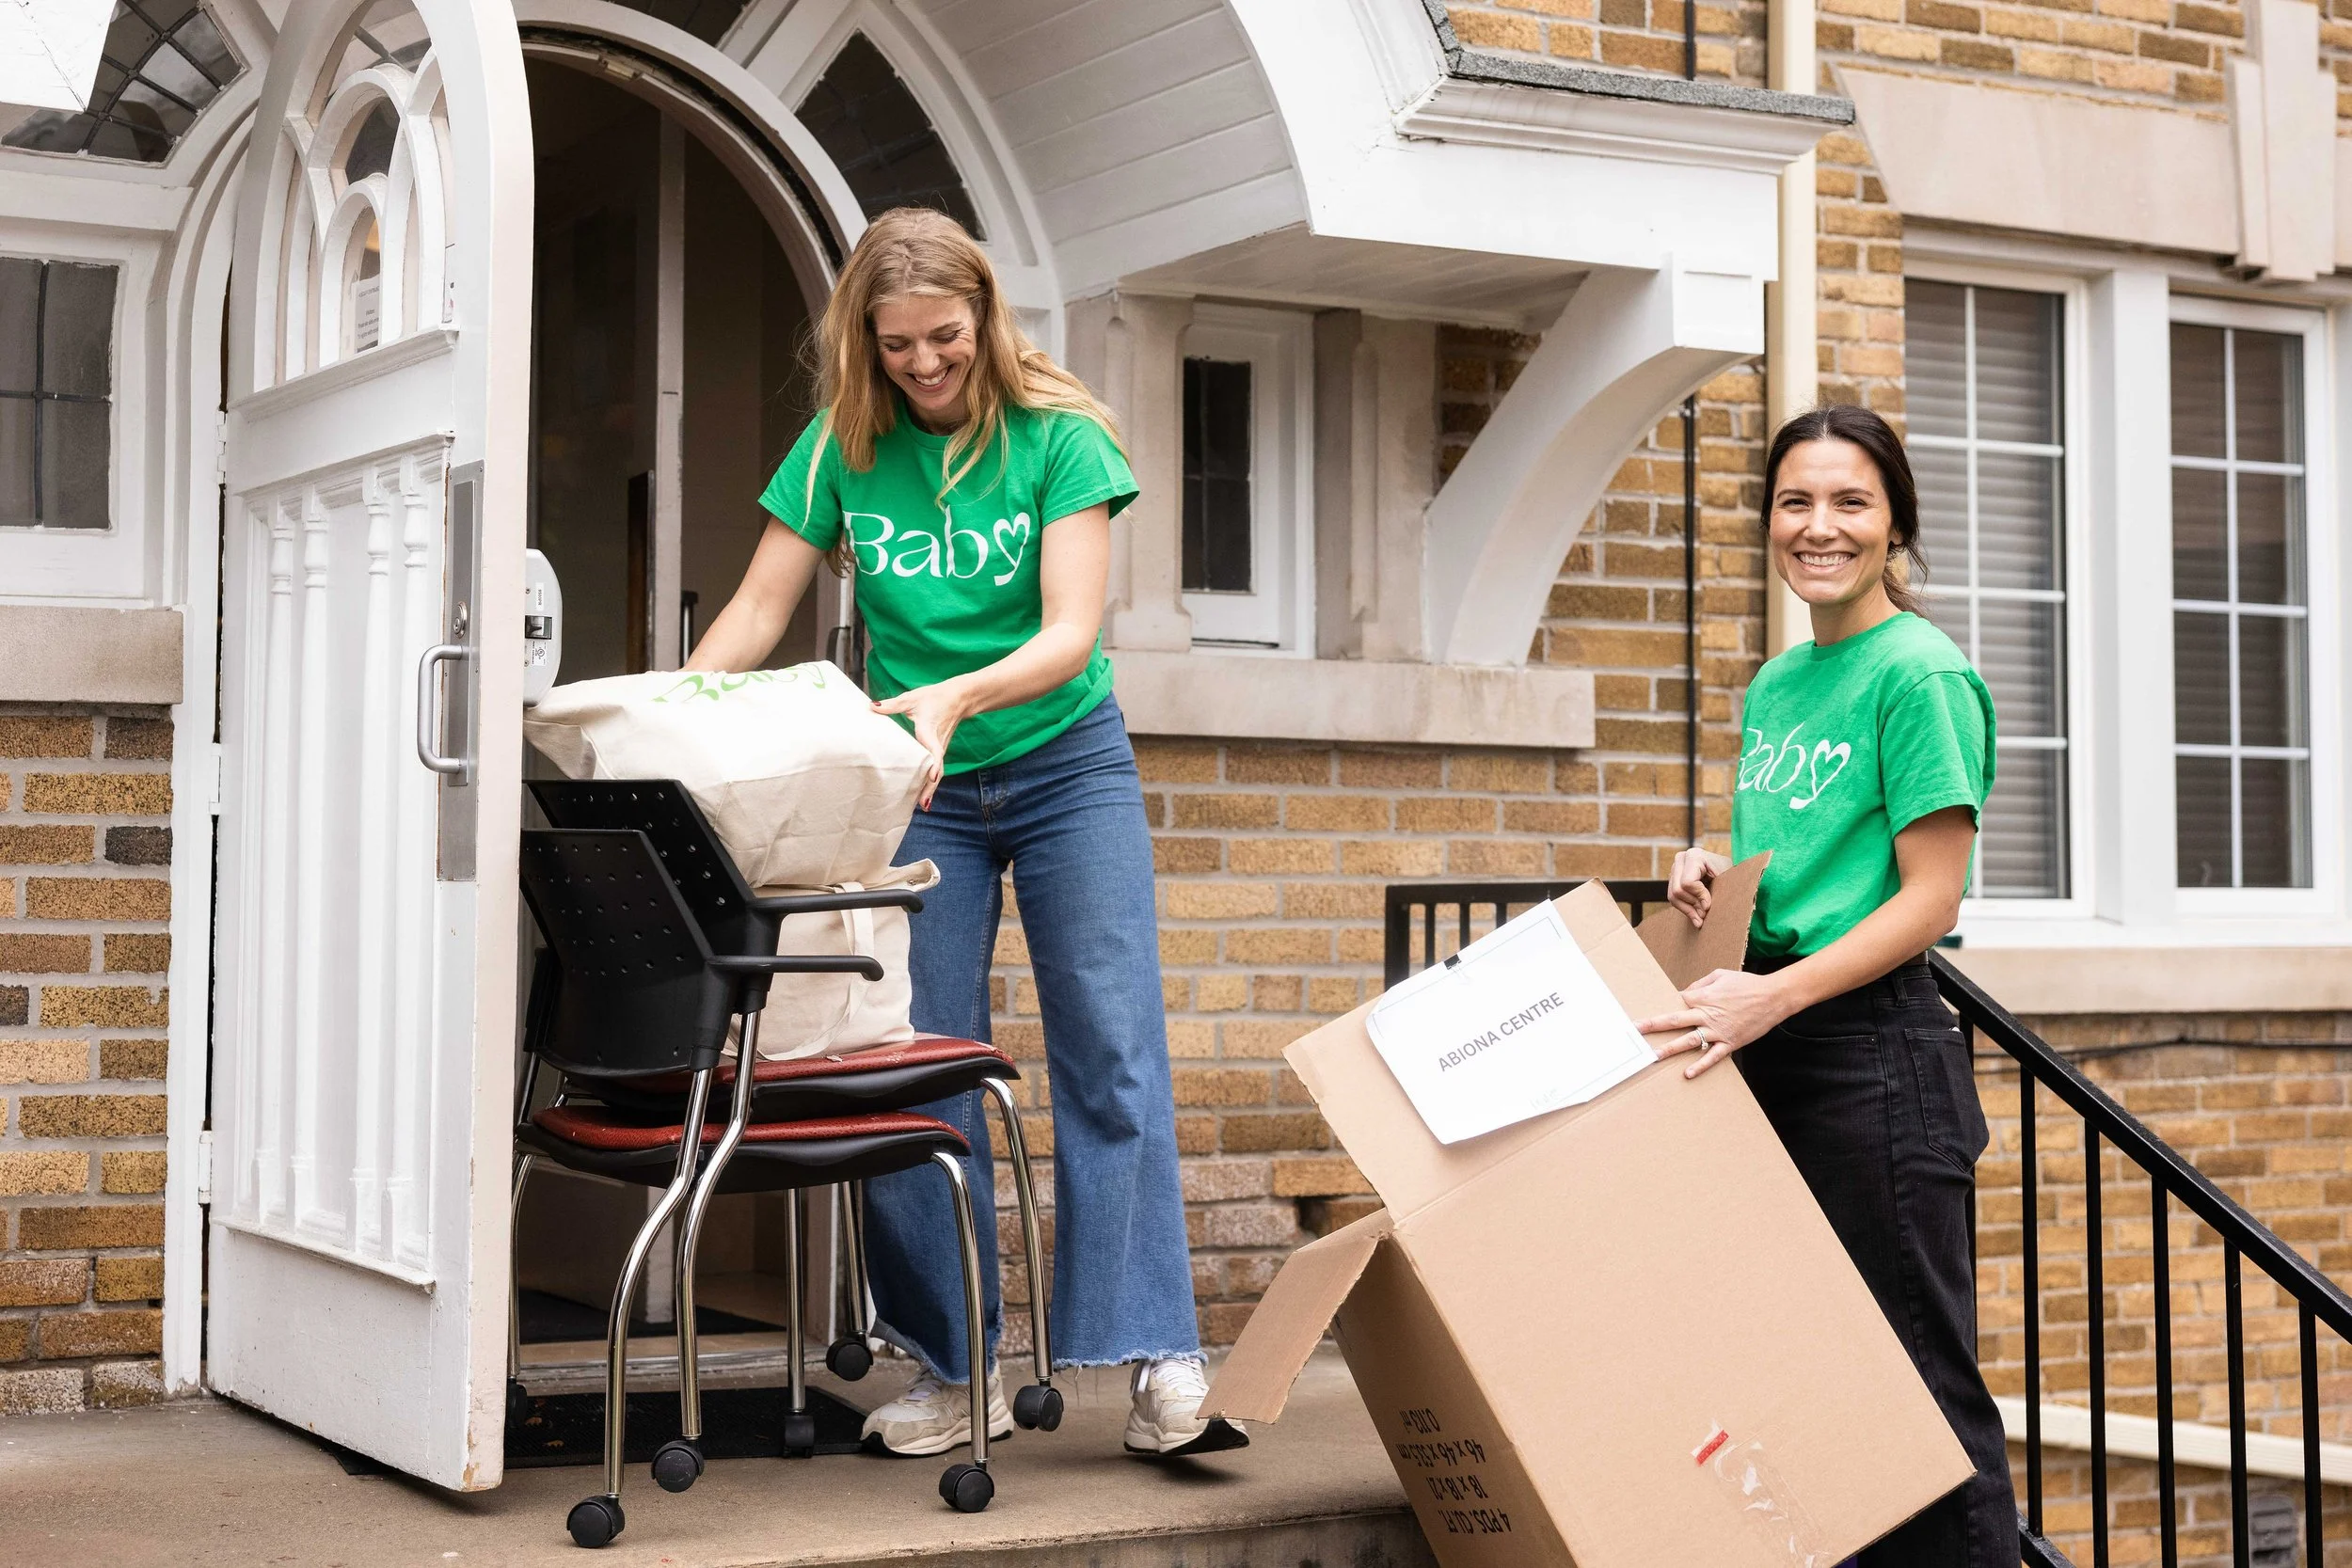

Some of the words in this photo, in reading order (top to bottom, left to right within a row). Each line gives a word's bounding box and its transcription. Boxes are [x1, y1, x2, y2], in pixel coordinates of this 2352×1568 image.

[842, 504, 1031, 586] Baby
[1438, 1030, 1501, 1072] ABIONA
[1500, 991, 1565, 1037] CENTRE
[1408, 1407, 1441, 1434] 0.113
[1408, 1444, 1435, 1467] 53.5
[1426, 1443, 1440, 1461] x
[1437, 1442, 1458, 1466] 46
[1453, 1440, 1468, 1458] x
[1464, 1439, 1486, 1464] 46
[1425, 1477, 1444, 1500] 21
[1444, 1477, 1465, 1501] 18
[1455, 1476, 1470, 1493] x
[1468, 1475, 1489, 1499] 18
[1469, 1509, 1504, 1534] PDS.
[1497, 1508, 1512, 1532] 4
